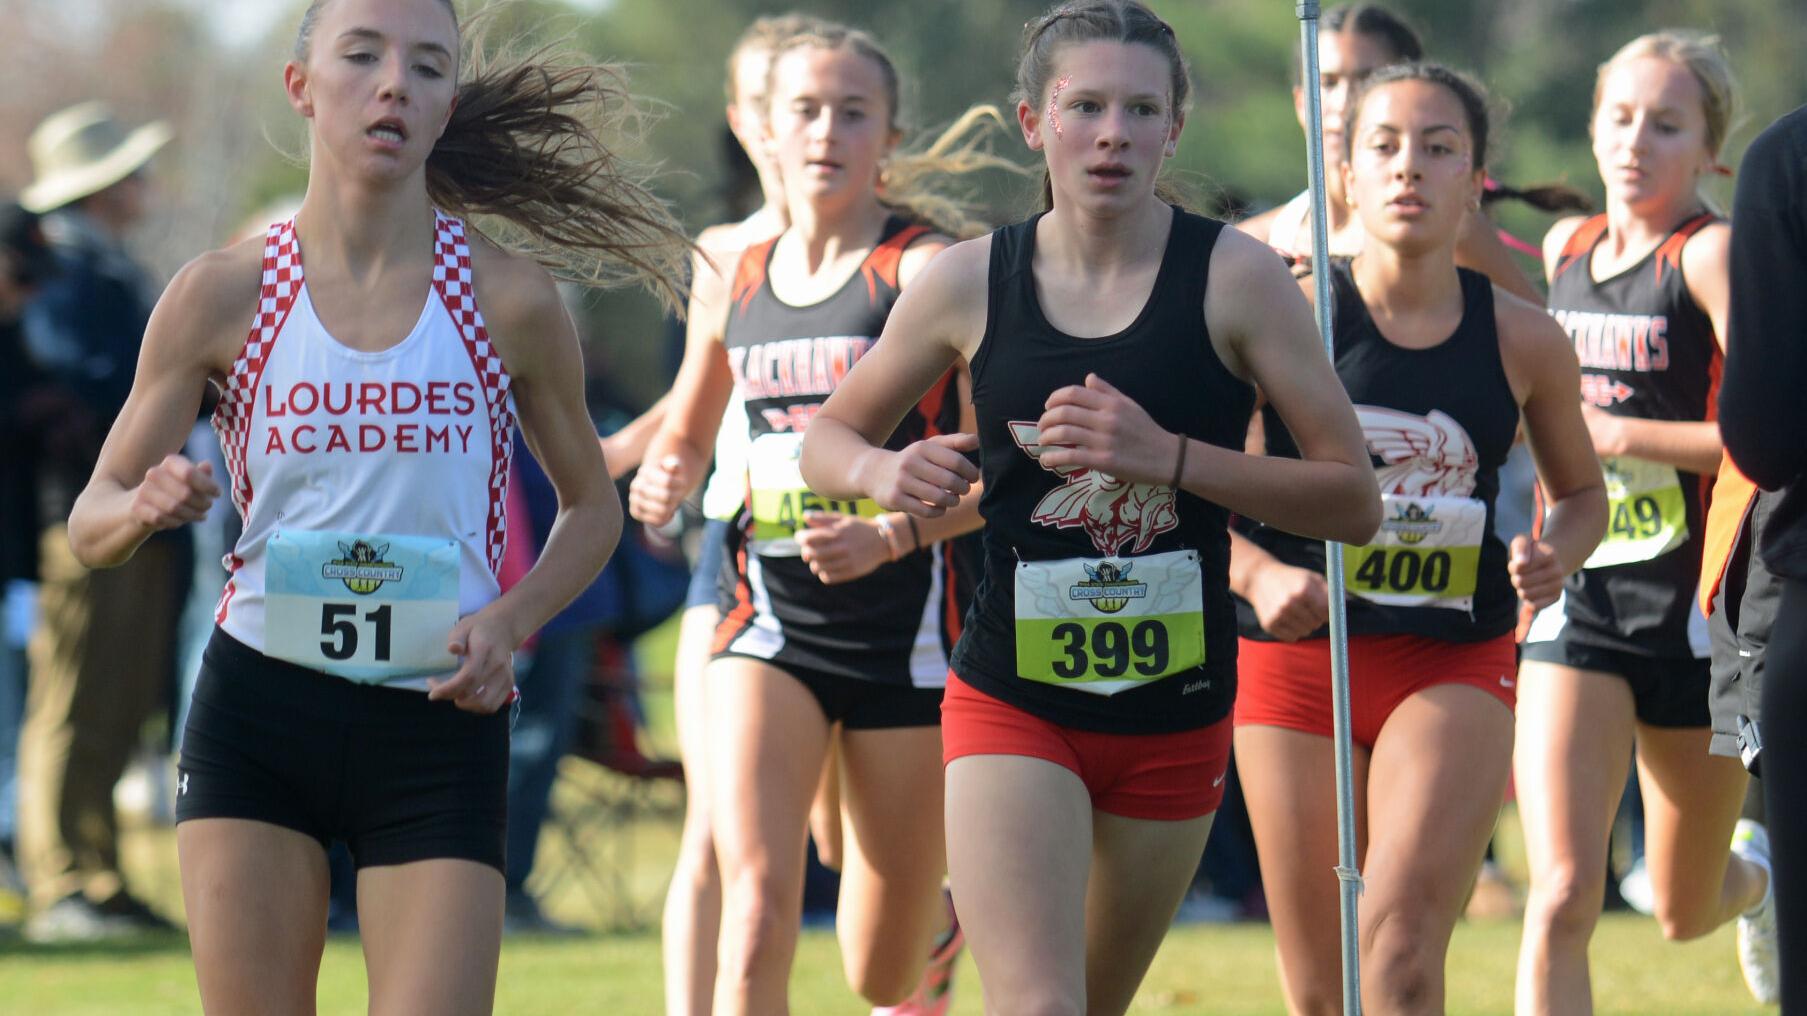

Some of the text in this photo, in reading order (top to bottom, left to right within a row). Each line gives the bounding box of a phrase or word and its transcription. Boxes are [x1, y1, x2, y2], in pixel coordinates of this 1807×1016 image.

[265, 382, 475, 417] LOURDES
[265, 424, 473, 454] ACADEMY
[1603, 496, 1662, 541] 49
[324, 564, 400, 579] CROSS COUNTRY
[1355, 549, 1451, 593] 400
[1072, 585, 1145, 598] CROSS COUNTRY
[320, 603, 391, 661] 51
[1051, 619, 1169, 679] 399
